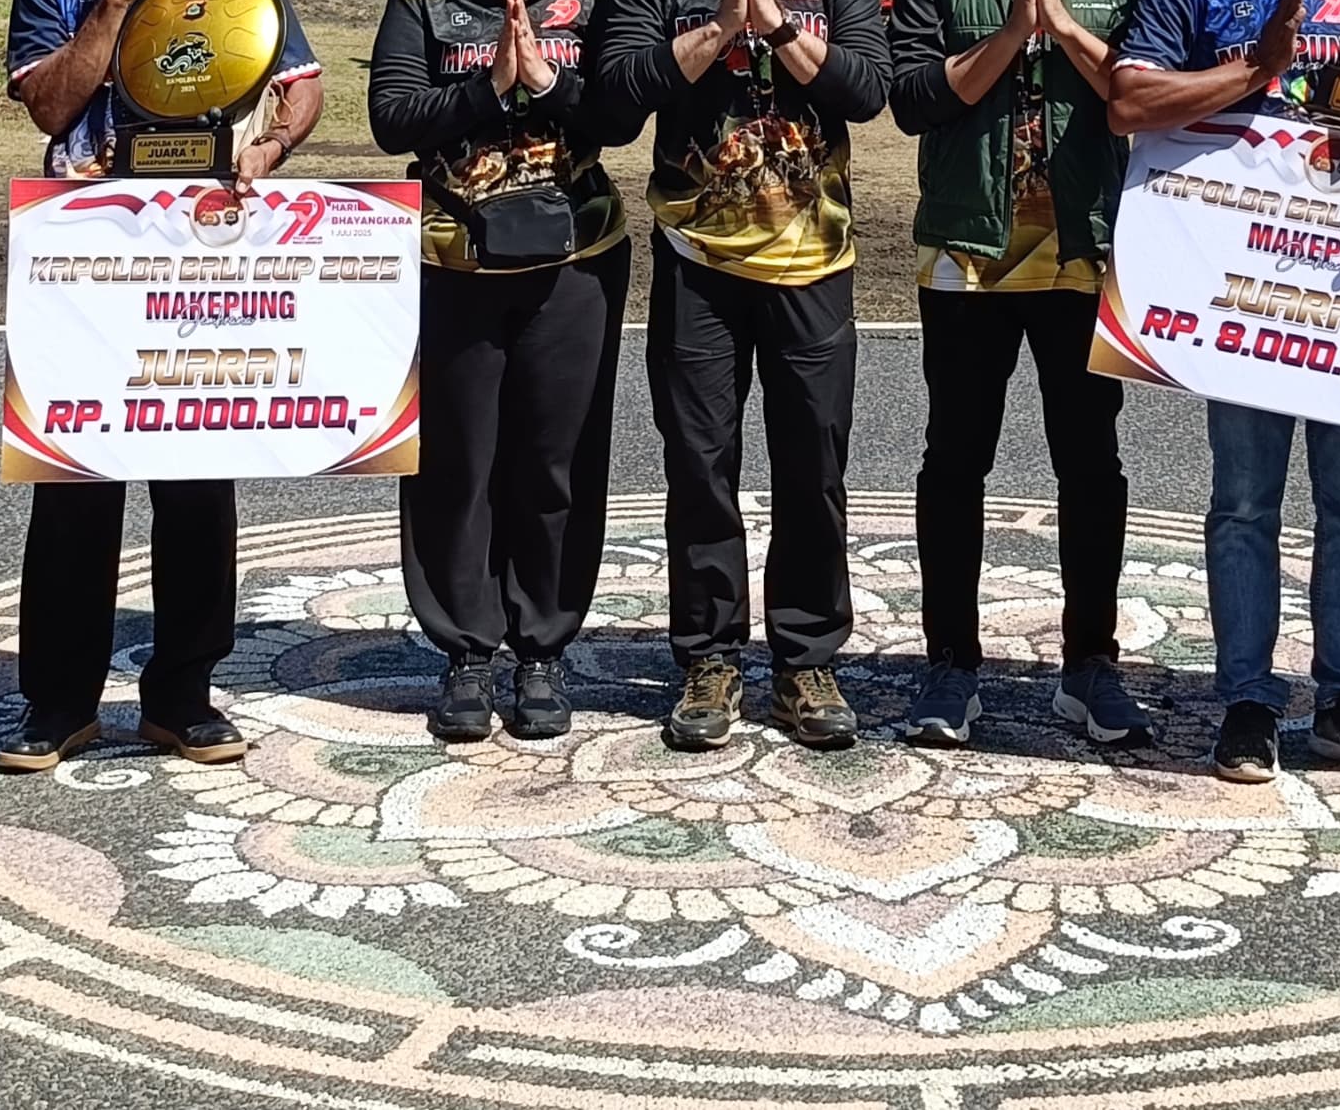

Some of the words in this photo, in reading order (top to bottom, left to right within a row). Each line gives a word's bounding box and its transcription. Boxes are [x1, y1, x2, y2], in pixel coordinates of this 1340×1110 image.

[148, 148, 186, 158] JUARA
[191, 148, 196, 156] 1
[332, 203, 357, 211] HARI
[1146, 168, 1282, 216] KAPOLDA
[331, 217, 413, 225] BHAYANGKARA
[29, 256, 171, 283] KAPOLDA
[179, 256, 247, 282] BALI
[253, 255, 315, 281] CUP
[319, 255, 401, 281] 2025
[145, 290, 296, 322] MAKEPUNG
[1141, 305, 1203, 346] RP.
[126, 348, 281, 388] JUARA
[288, 346, 307, 386] 1
[45, 400, 111, 434] RP.
[124, 396, 378, 435] 10.000.000,-
